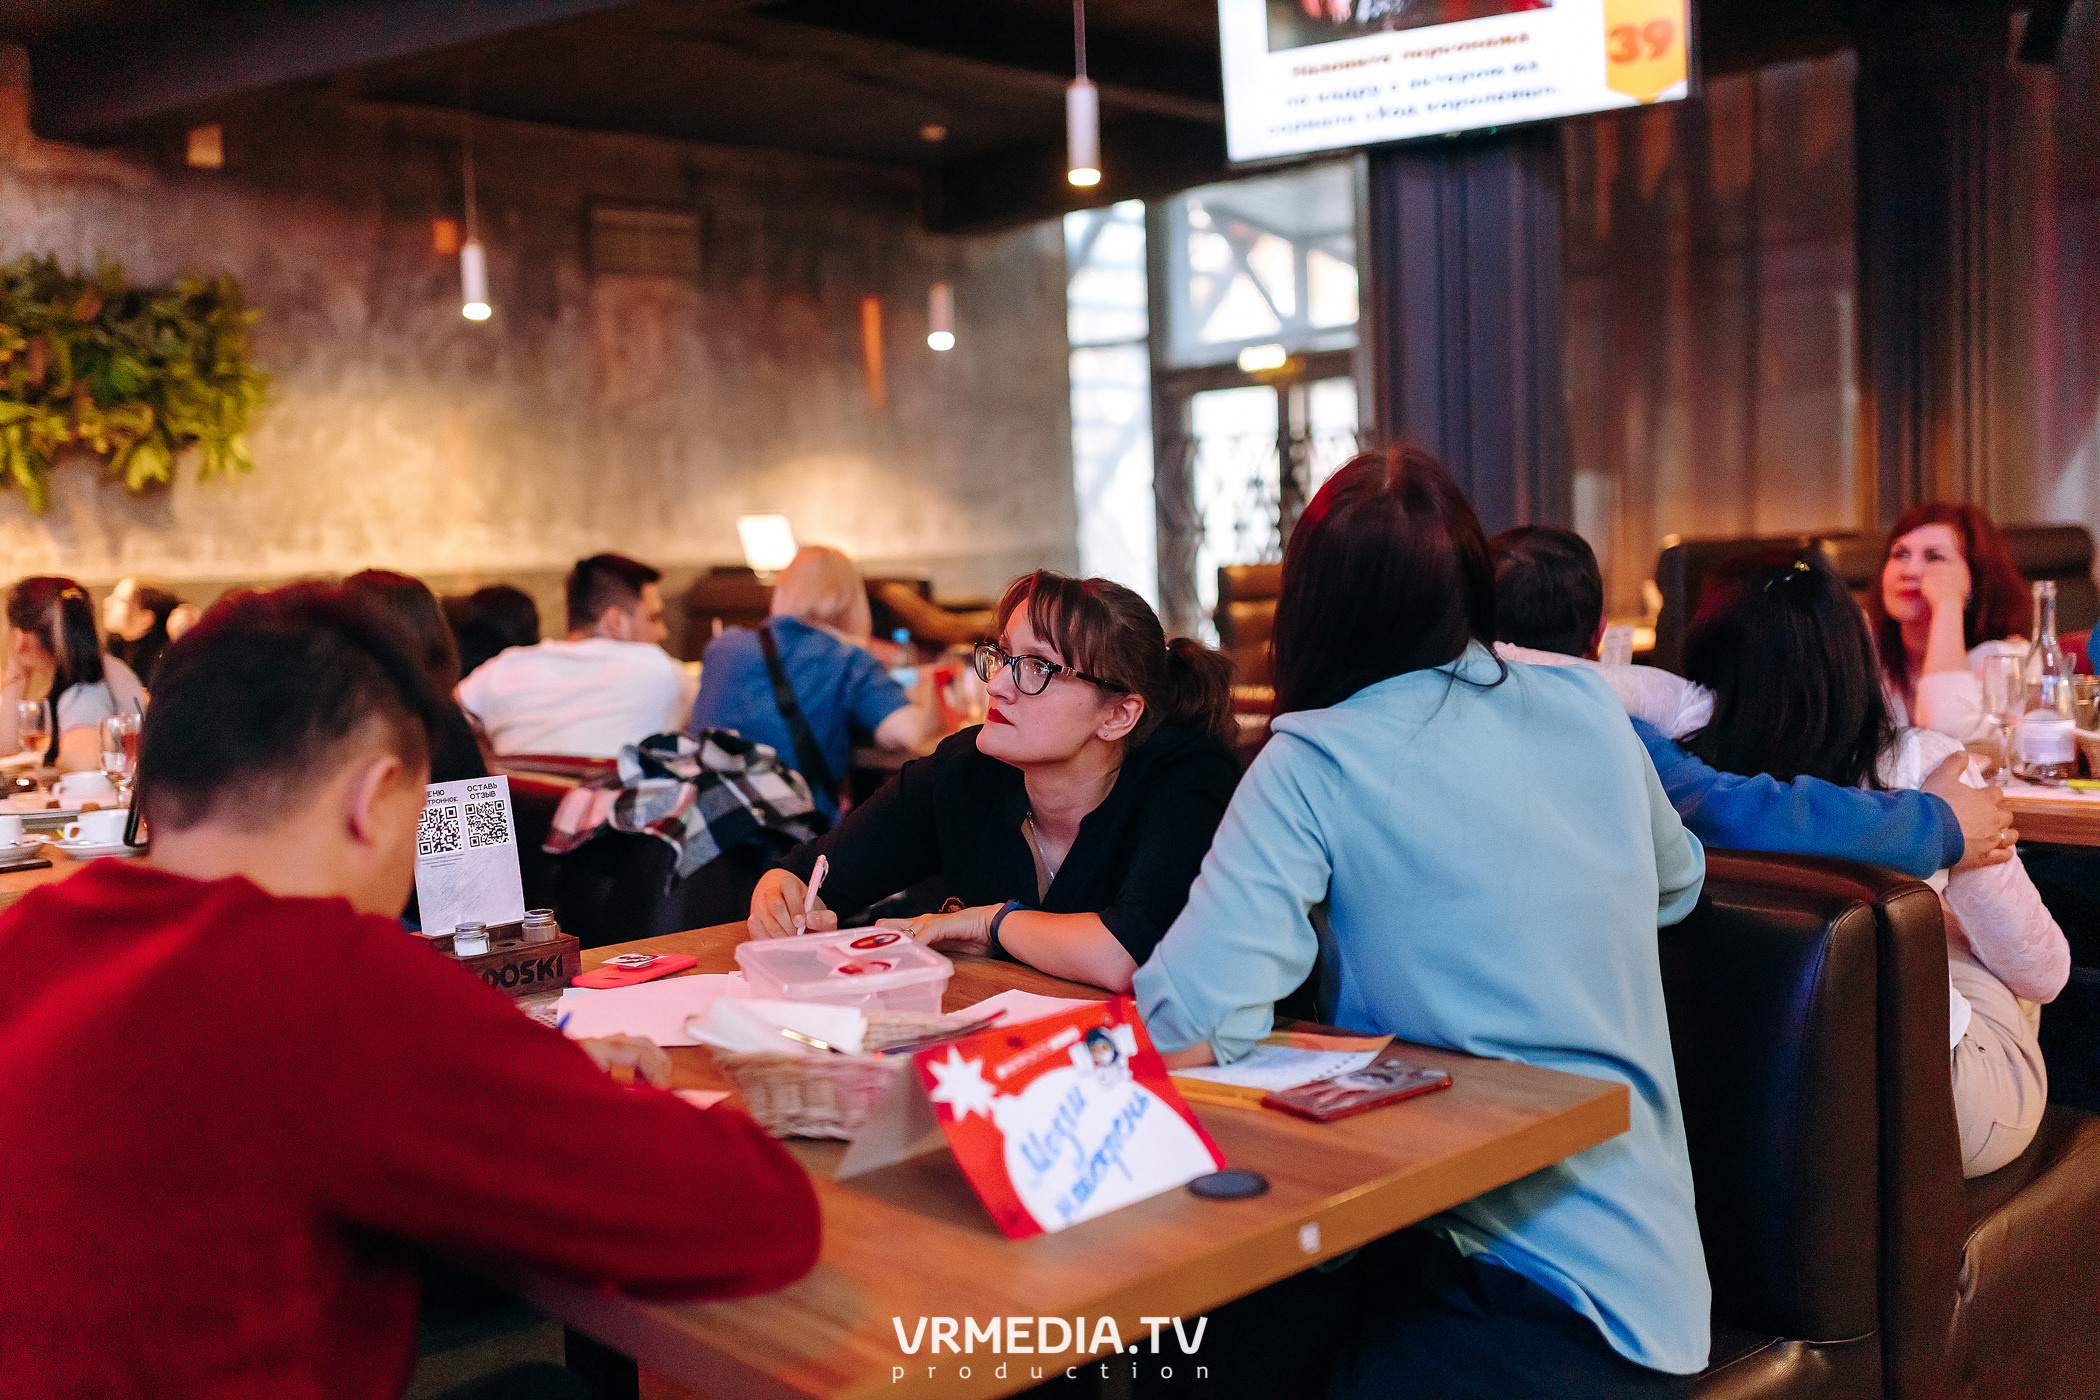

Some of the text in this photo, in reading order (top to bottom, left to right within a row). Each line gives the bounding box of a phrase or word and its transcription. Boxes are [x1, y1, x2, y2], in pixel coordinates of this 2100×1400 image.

[1608, 18, 1675, 64] 39
[427, 782, 498, 797] ЕНЮ ОСТАВЬ
[427, 791, 496, 806] ТРОННОЕ ОТЗЫВ
